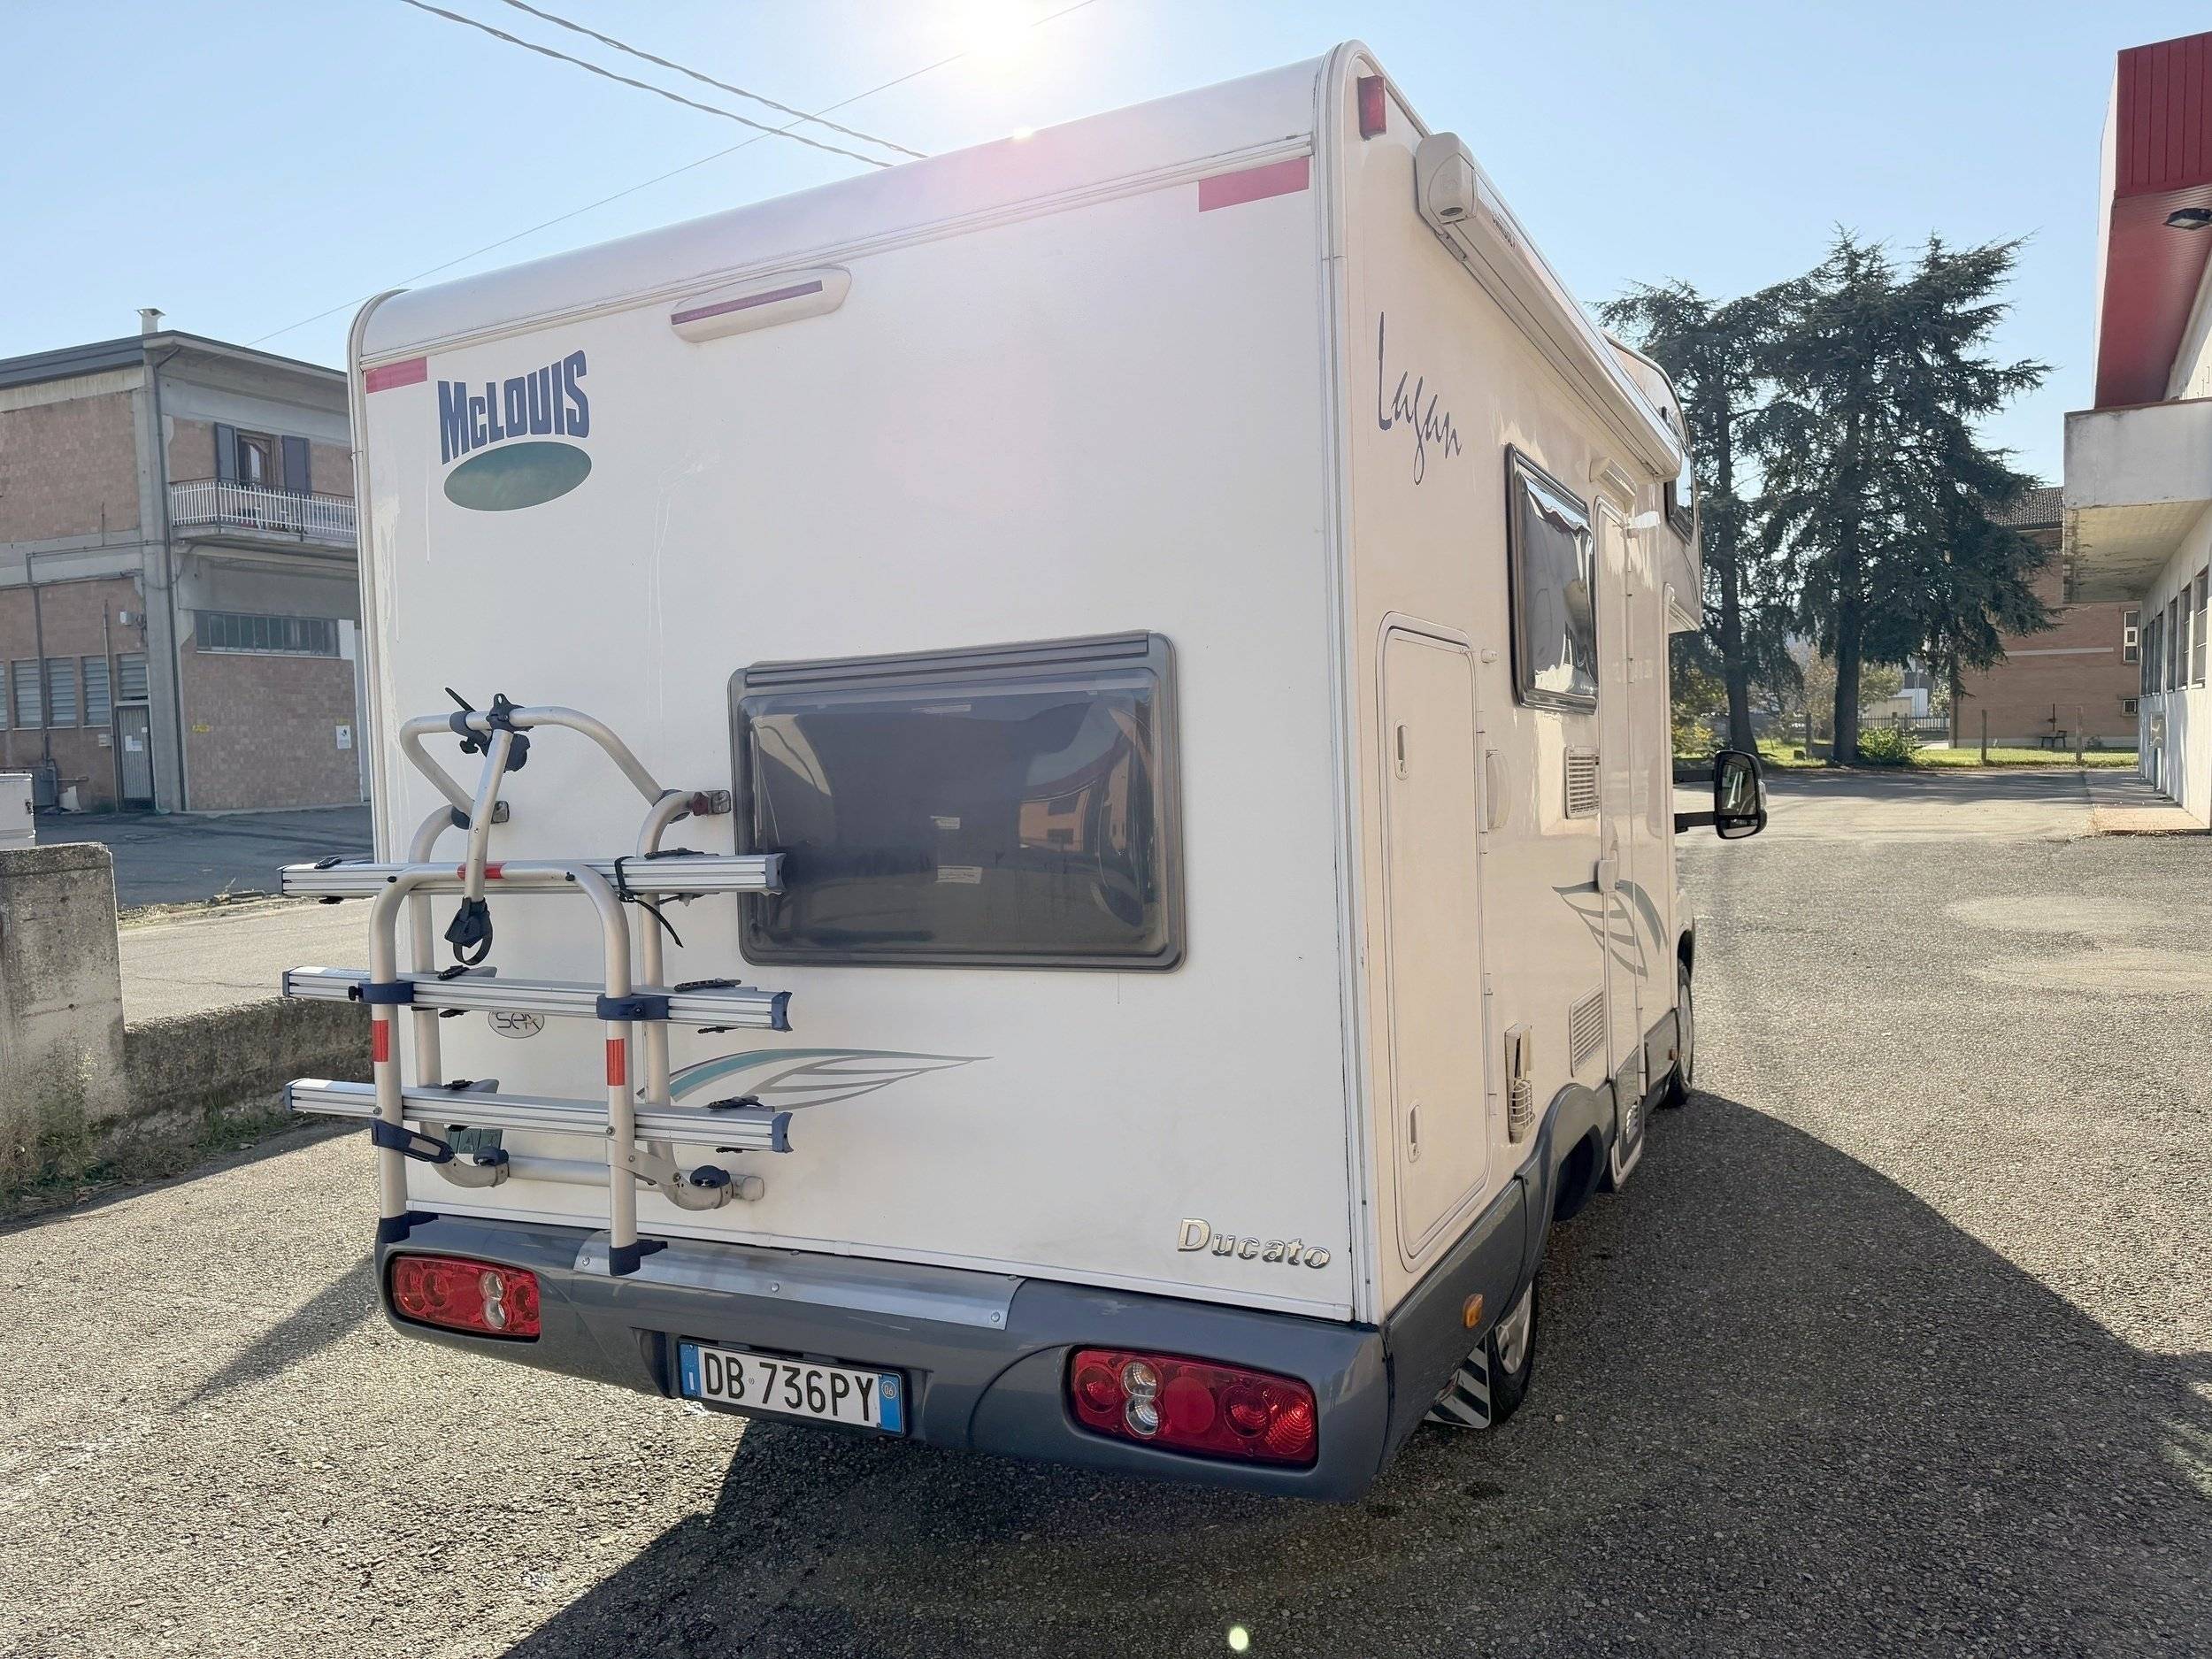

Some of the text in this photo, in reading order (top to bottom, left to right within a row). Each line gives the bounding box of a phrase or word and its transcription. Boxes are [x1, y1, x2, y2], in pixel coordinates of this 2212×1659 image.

[437, 349, 590, 465] McLOUIS
[1379, 311, 1462, 486] Lagan
[1177, 1217, 1332, 1269] Ducato
[704, 1352, 874, 1422] DB 736PY
